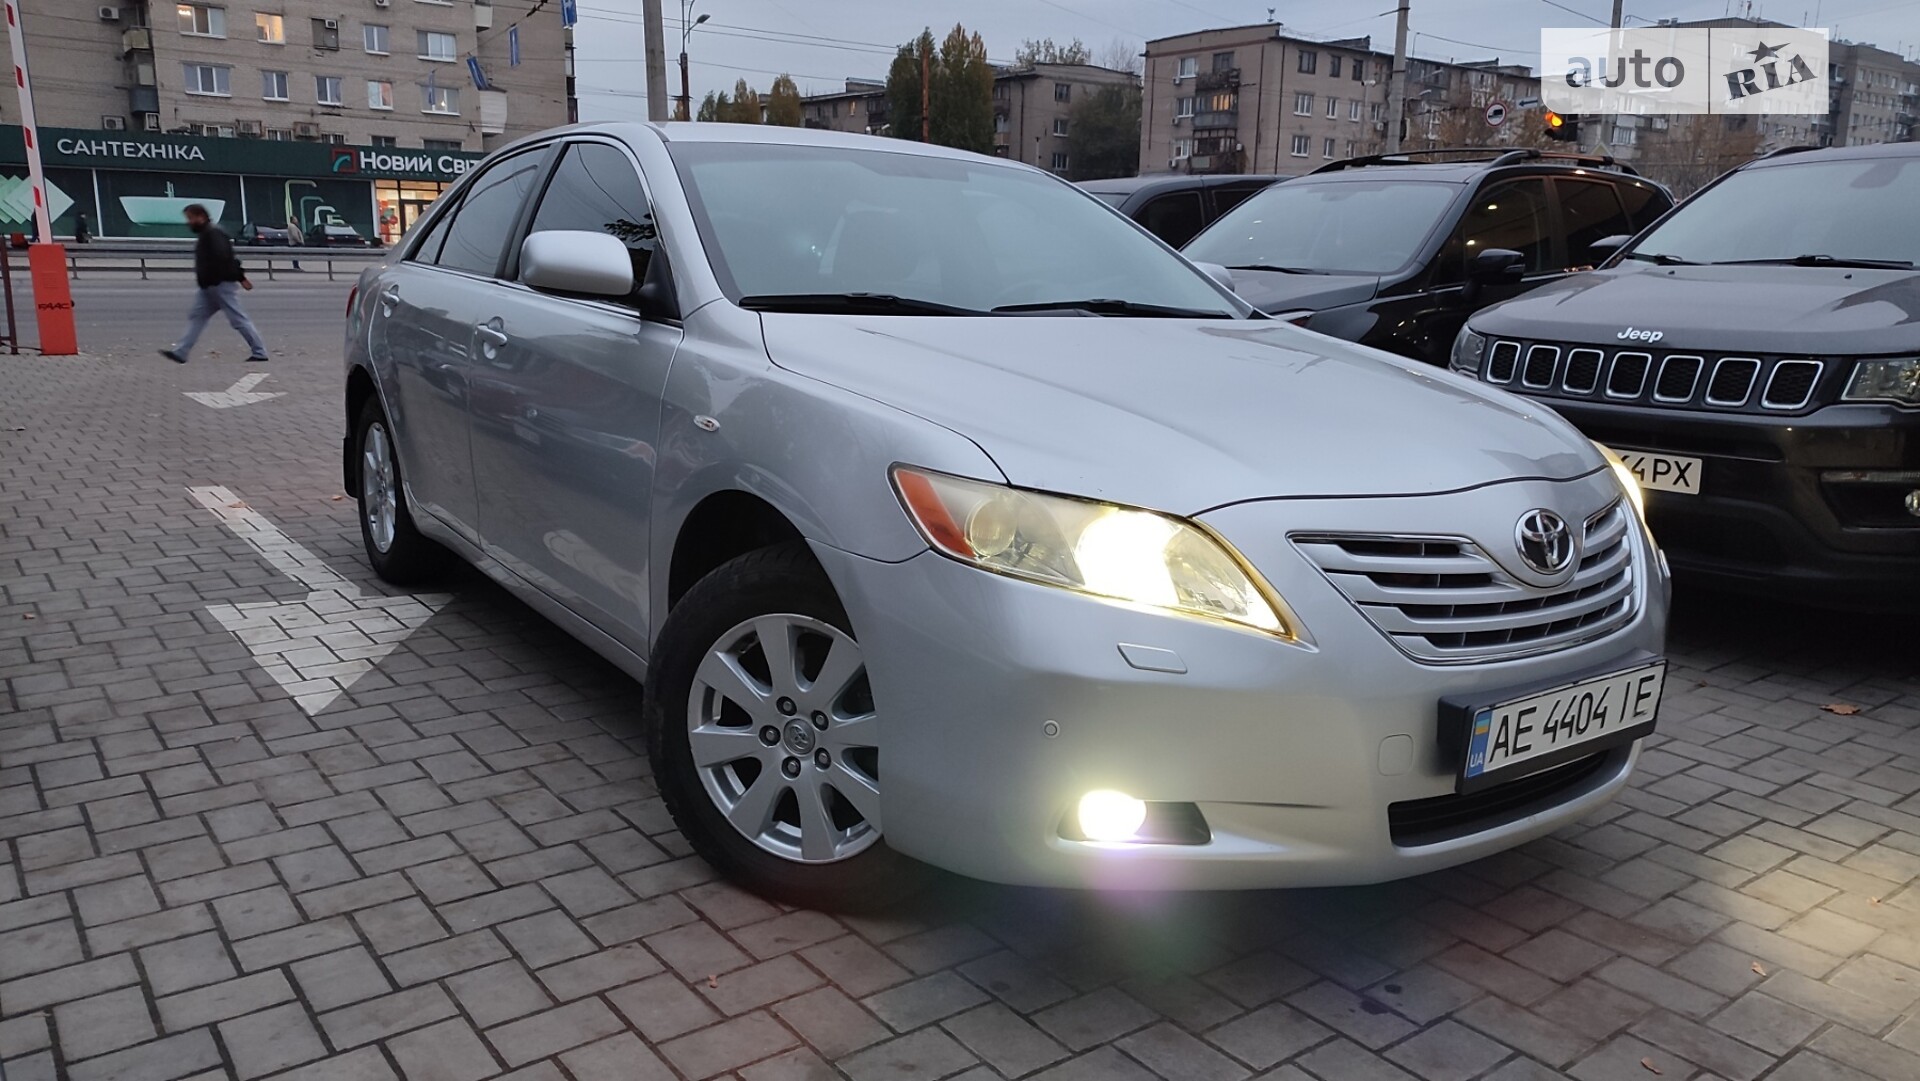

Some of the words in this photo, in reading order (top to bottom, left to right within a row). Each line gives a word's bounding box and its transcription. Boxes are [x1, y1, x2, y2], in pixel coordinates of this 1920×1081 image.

[56, 138, 205, 161] САНТЕХНІКА
[38, 302, 70, 310] FAAC
[1617, 327, 1663, 343] Jeep
[1488, 706, 1537, 763] AE
[1542, 686, 1610, 744] 4404
[1619, 675, 1655, 723] IE
[1470, 752, 1484, 768] UA
